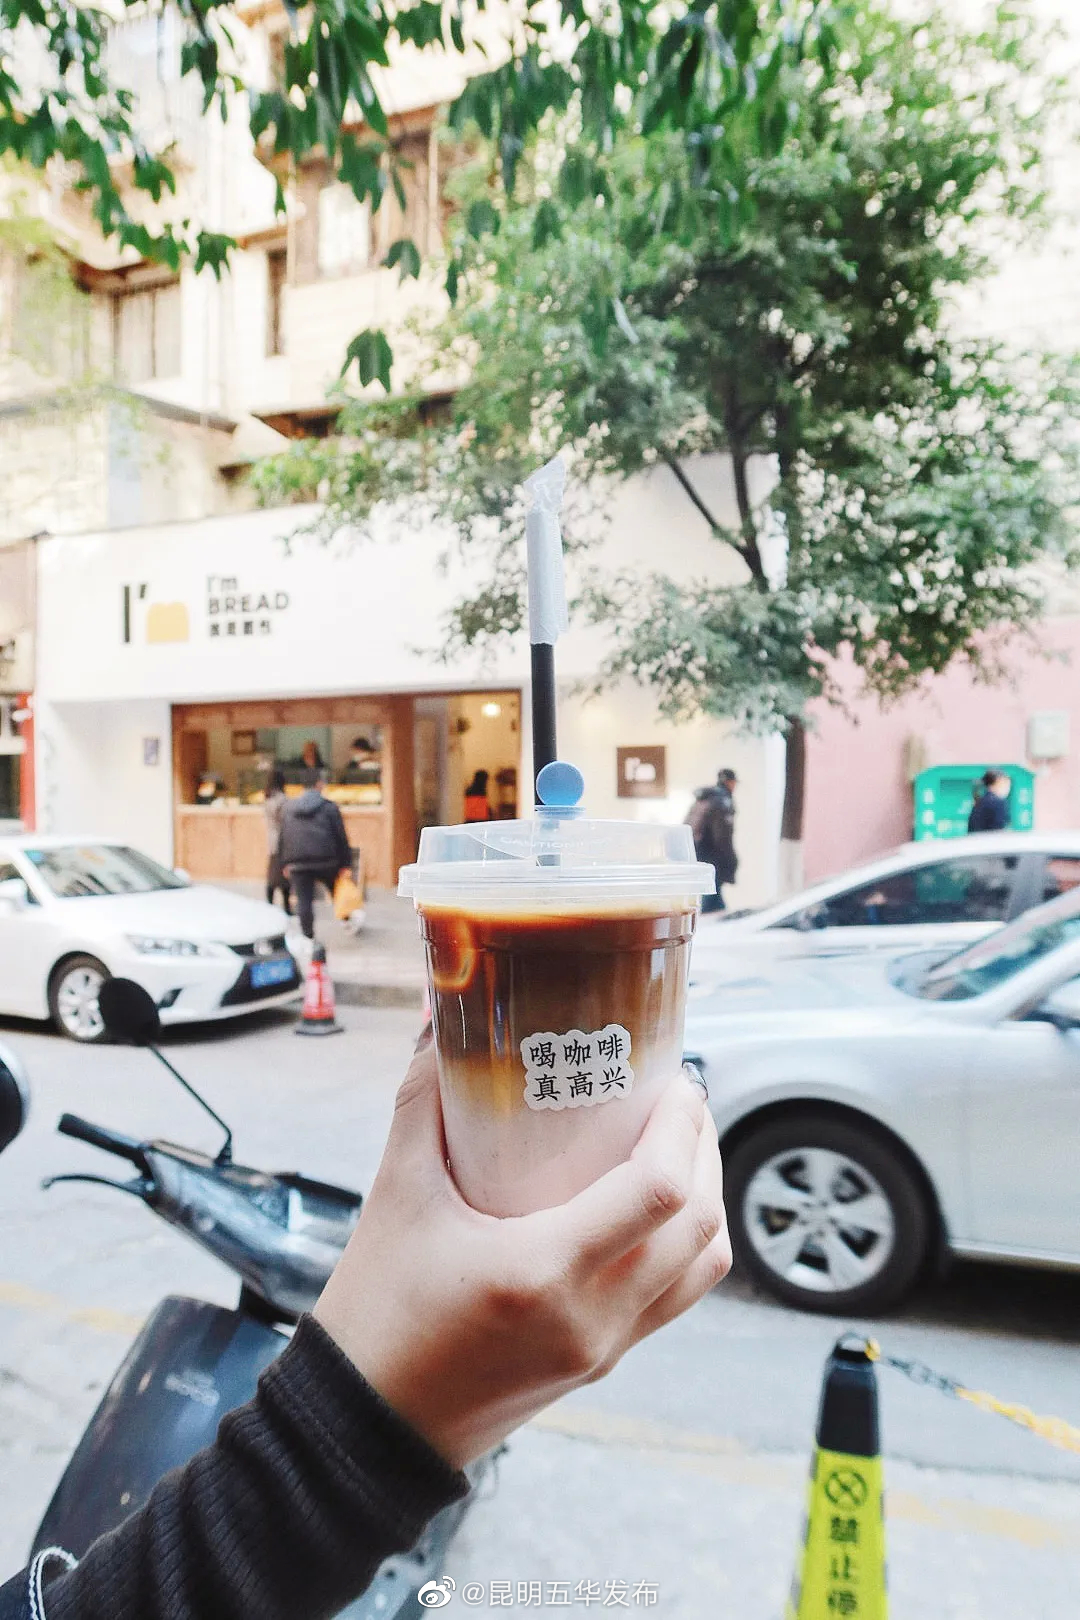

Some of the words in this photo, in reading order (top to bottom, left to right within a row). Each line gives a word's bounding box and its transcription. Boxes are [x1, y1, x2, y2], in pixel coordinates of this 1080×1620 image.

[208, 592, 289, 615] BREAD
[529, 1033, 624, 1070] 喝咖啡
[533, 1066, 627, 1102] 真高兴
